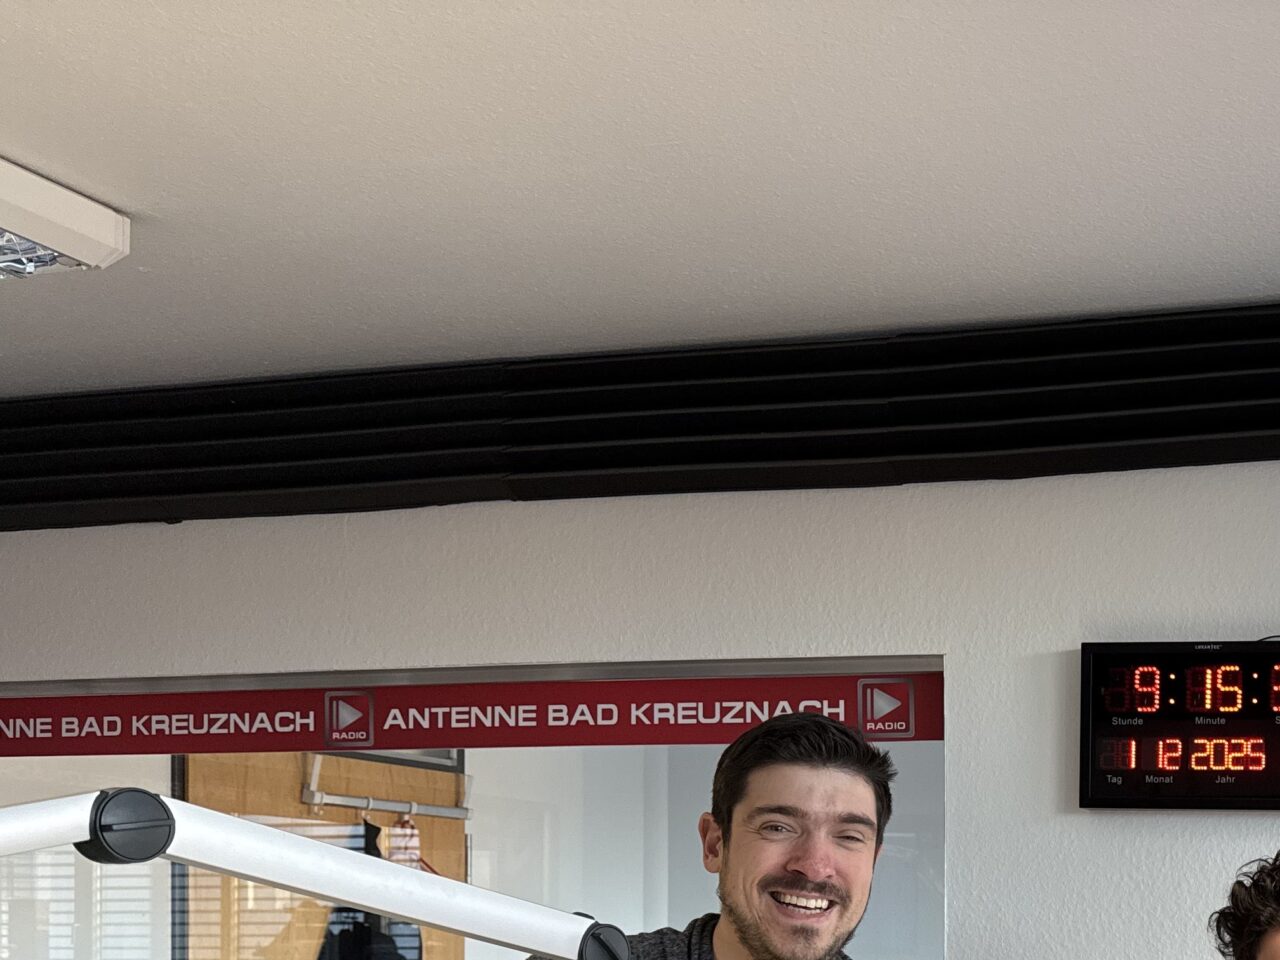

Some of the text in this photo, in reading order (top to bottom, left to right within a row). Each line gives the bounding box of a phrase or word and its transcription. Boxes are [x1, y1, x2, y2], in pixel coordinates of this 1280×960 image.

[383, 704, 538, 730] ANTENNE
[547, 703, 619, 726] BAD
[1111, 716, 1144, 726] Stunde
[1195, 715, 1226, 726] Minute
[61, 715, 122, 737] BAD
[131, 710, 315, 735] KREUZNACH
[866, 722, 906, 731] RADIO
[332, 730, 367, 740] RADIO
[1190, 738, 1266, 771] 2025
[1106, 774, 1123, 786] Tag
[1145, 774, 1174, 784] Monat
[1215, 774, 1237, 784] Jahr
